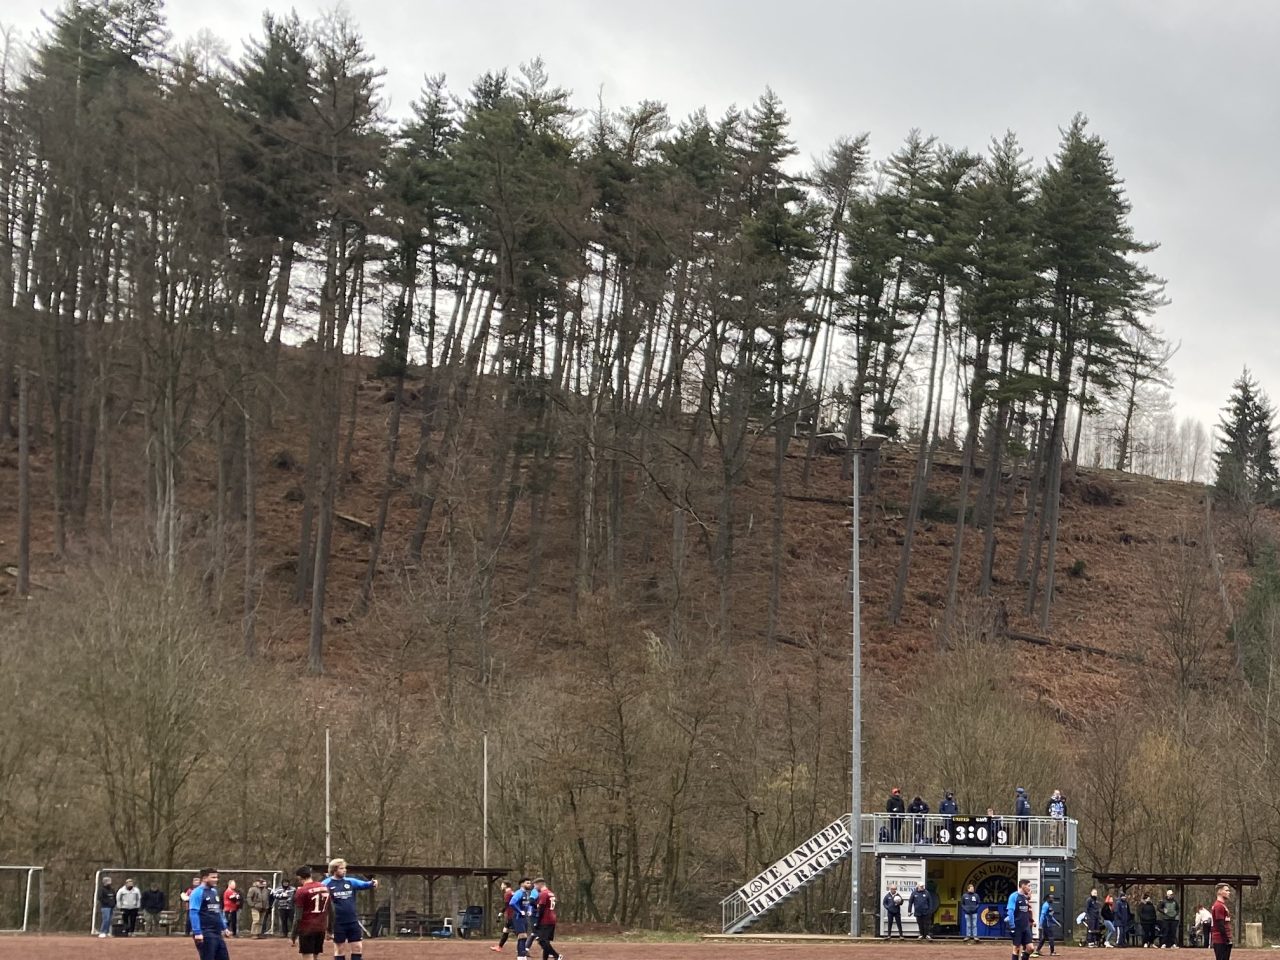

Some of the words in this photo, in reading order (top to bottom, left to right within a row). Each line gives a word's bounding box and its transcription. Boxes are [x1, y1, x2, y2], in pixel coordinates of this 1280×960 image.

[782, 822, 843, 869] UNITED
[750, 878, 795, 916] HATE
[794, 835, 853, 884] RACISM
[311, 893, 330, 914] 17
